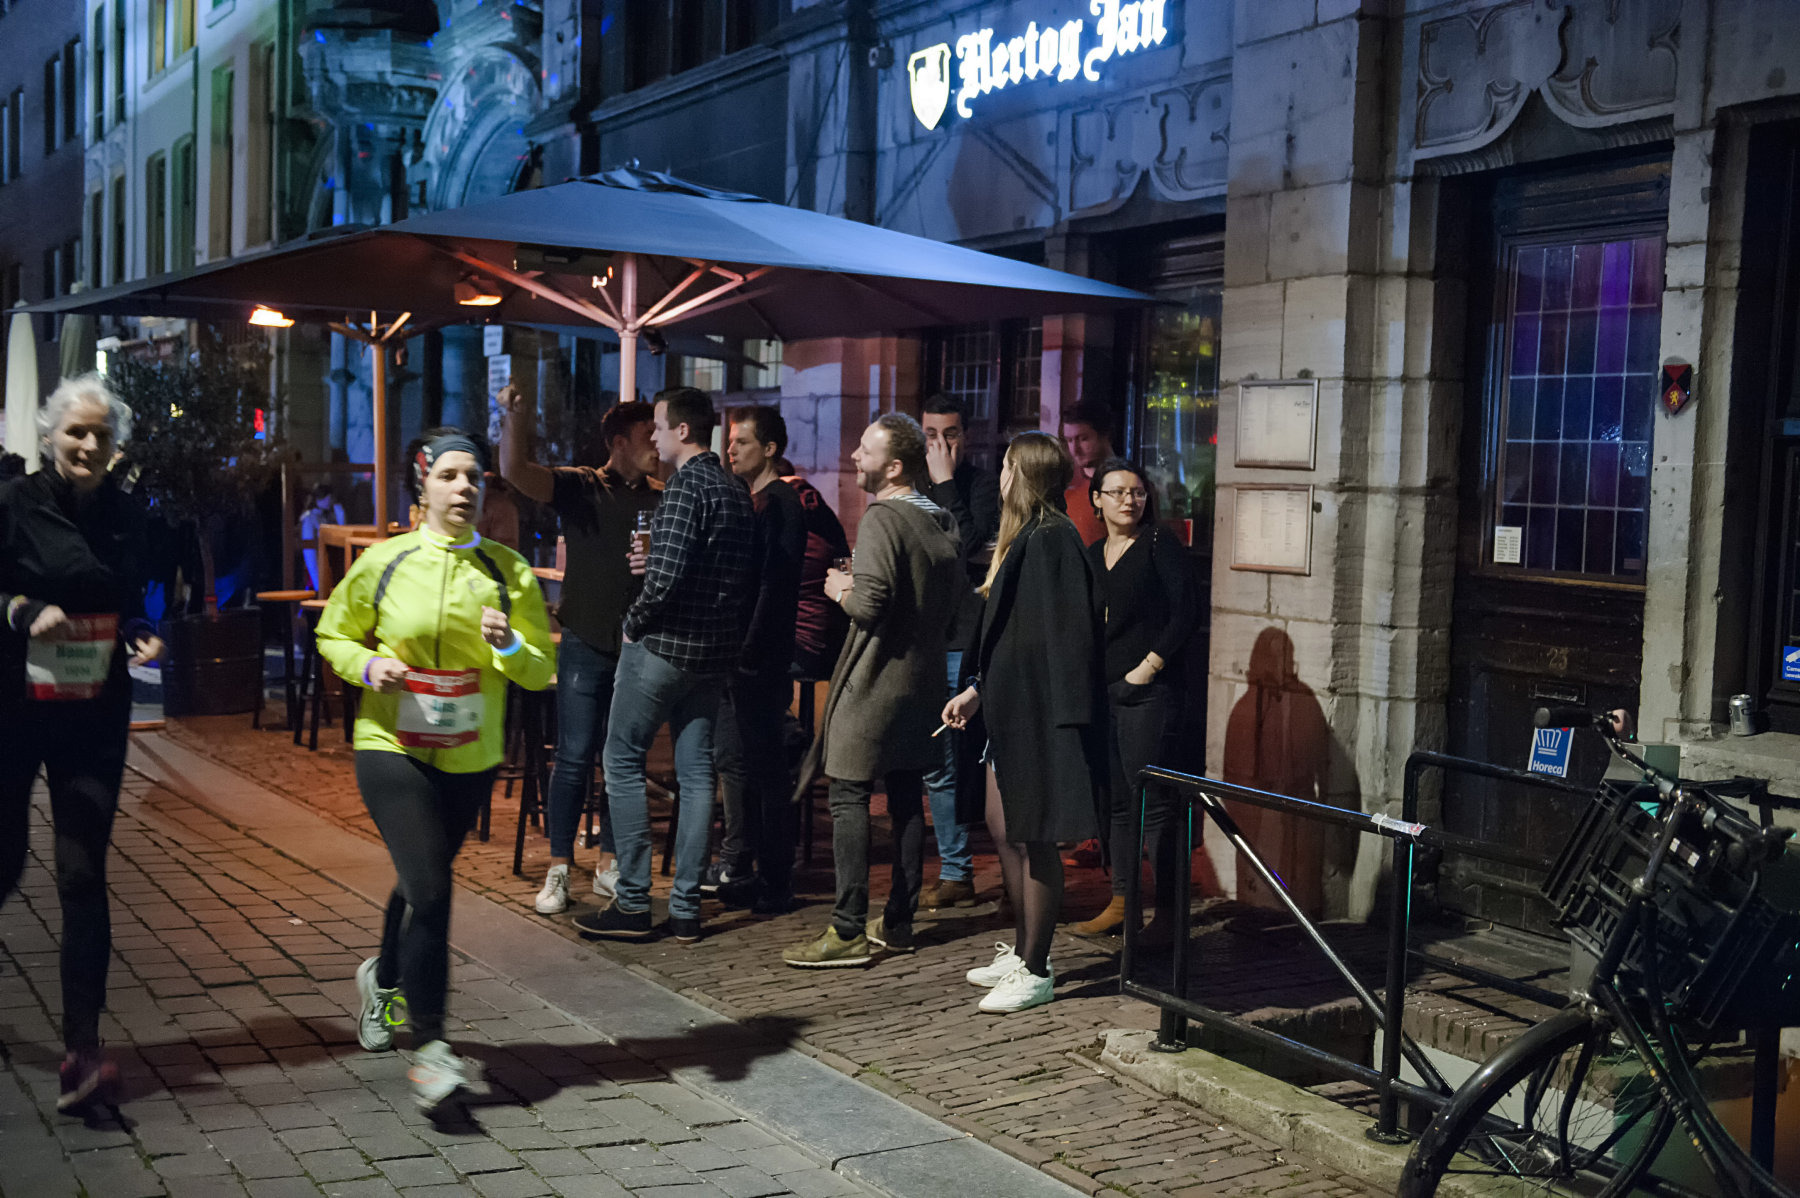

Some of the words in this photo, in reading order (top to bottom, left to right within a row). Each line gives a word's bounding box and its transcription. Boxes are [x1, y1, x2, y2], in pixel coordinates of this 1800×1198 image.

[956, 19, 1083, 118] Hertog
[1084, 0, 1167, 81] Jan
[1532, 760, 1563, 775] Horeca
